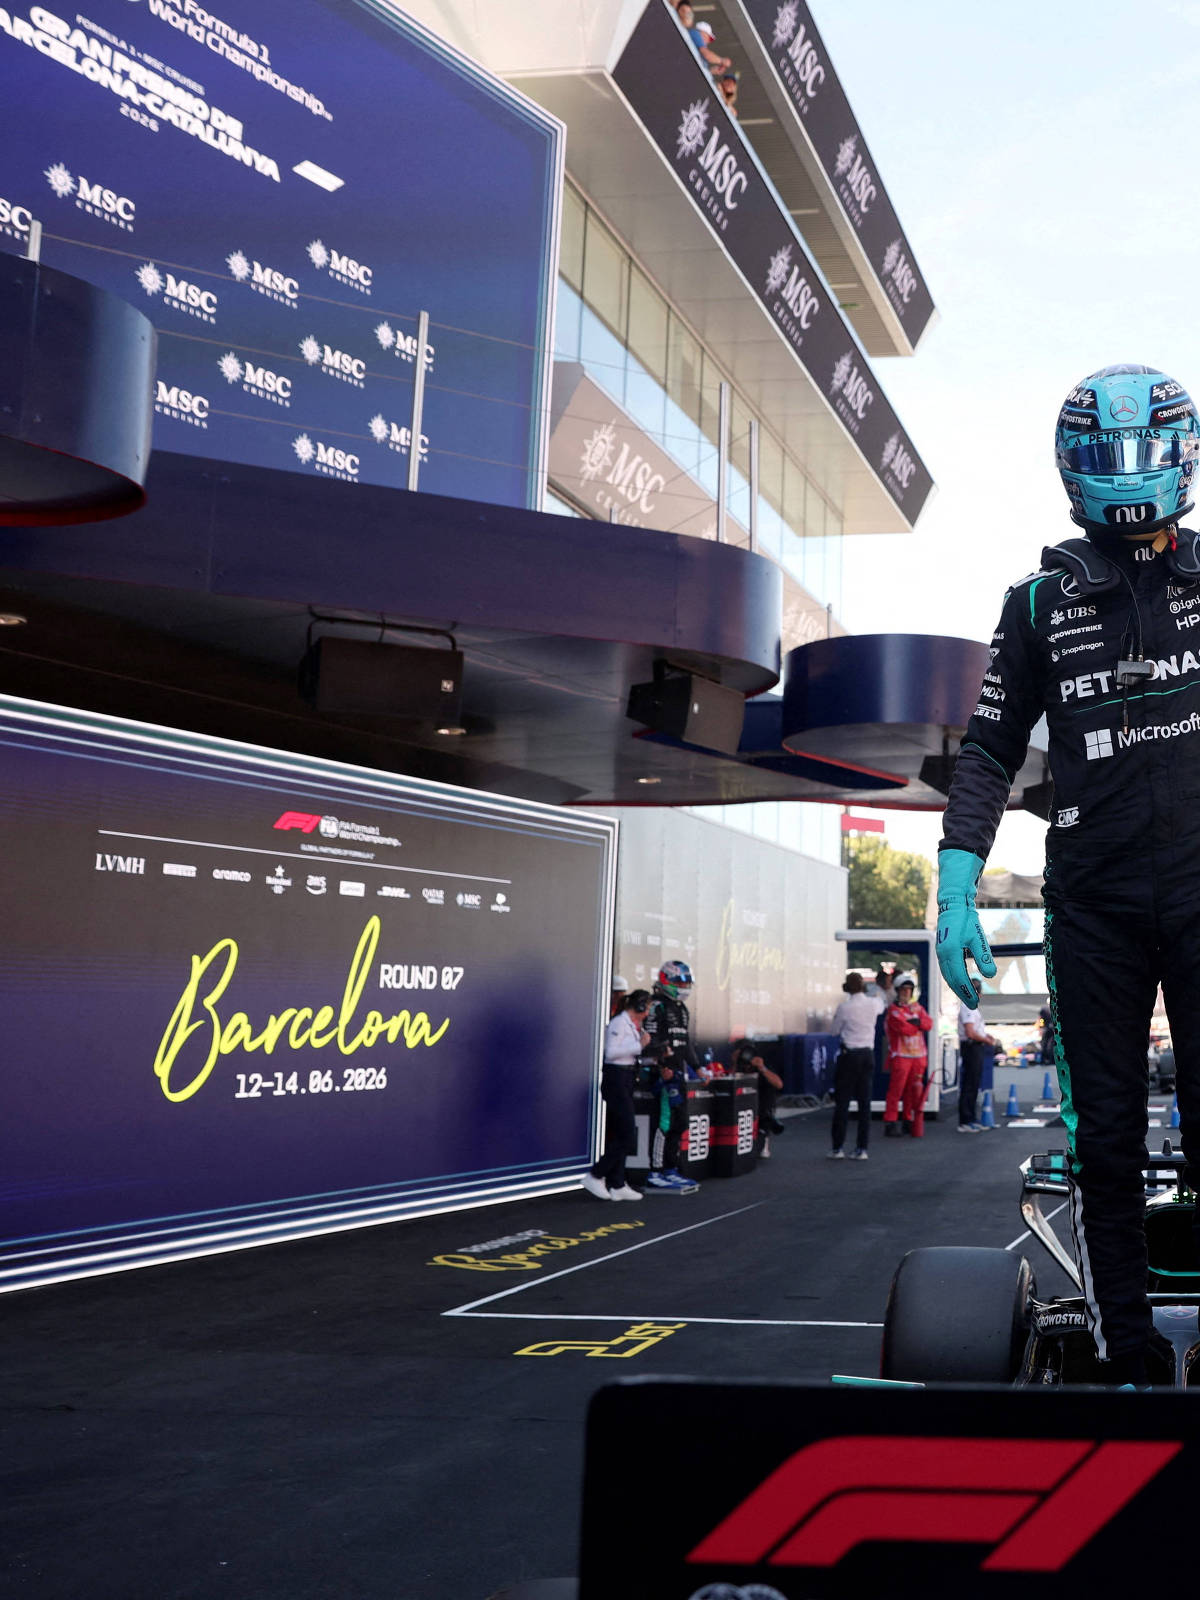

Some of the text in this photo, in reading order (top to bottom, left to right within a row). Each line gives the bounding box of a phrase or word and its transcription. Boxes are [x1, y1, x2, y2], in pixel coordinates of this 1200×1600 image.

[184, 0, 272, 66] Formula 1
[29, 6, 244, 142] GRAN PREMIO DE
[148, 0, 326, 116] World Championship
[786, 23, 827, 98] MSC
[119, 102, 160, 133] 2026
[696, 126, 748, 211] MSC
[845, 154, 877, 214] MSC
[77, 175, 136, 221] MSC
[252, 260, 299, 300] MSC
[330, 249, 373, 287] MSC
[893, 254, 919, 304] MSC
[165, 273, 219, 315] MSC
[779, 264, 821, 331] MSC
[244, 361, 293, 399] MSC
[322, 344, 367, 381] MSC
[156, 380, 210, 419] MSC
[841, 366, 874, 421] MSC
[1088, 429, 1161, 445] PETRONAS
[315, 441, 361, 476] MSC
[605, 442, 666, 514] MSC
[892, 444, 917, 490] MSC
[1115, 504, 1146, 524] nu
[1050, 623, 1103, 641] CROWDSTRIKE
[1067, 605, 1097, 620] UBS
[1061, 641, 1104, 656] Snapdragon
[95, 853, 146, 875] LVMH
[379, 963, 465, 991] ROUND 07
[154, 914, 451, 1103] Barcelona
[234, 1066, 388, 1099] 12-14.06.2026
